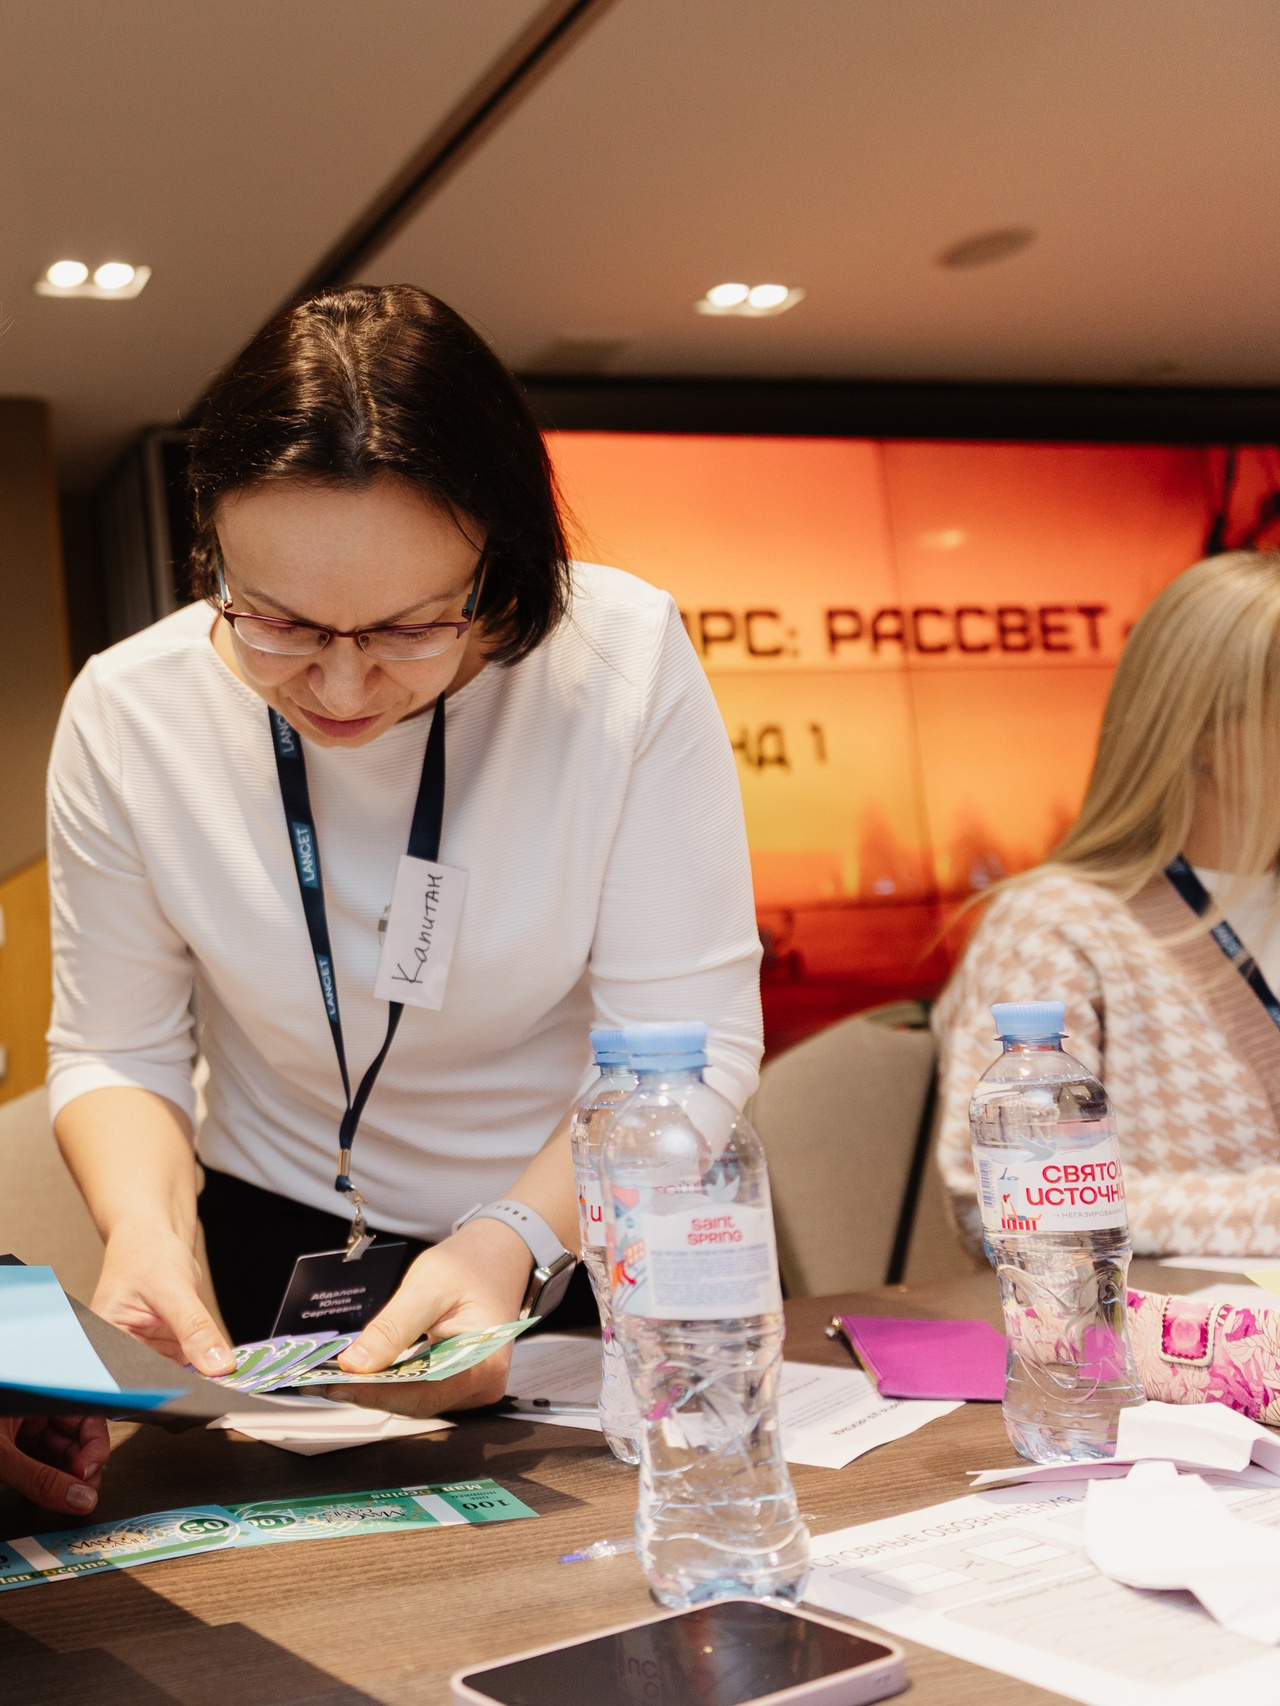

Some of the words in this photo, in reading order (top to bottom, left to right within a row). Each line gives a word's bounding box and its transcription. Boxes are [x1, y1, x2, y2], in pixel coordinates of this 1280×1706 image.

[680, 608, 799, 658] РС:
[826, 604, 1107, 657] РАССВЕТ
[276, 711, 295, 753] LANC
[808, 722, 828, 766] 1
[296, 827, 315, 883] LANCET
[319, 958, 337, 1016] LANCET
[301, 1303, 363, 1319] Сергеевна
[319, 1297, 352, 1308] Юлия
[462, 1498, 511, 1511] 100
[921, 1495, 1077, 1538] ОБОЗНАЧЕНИЯ
[183, 1520, 224, 1534] 50
